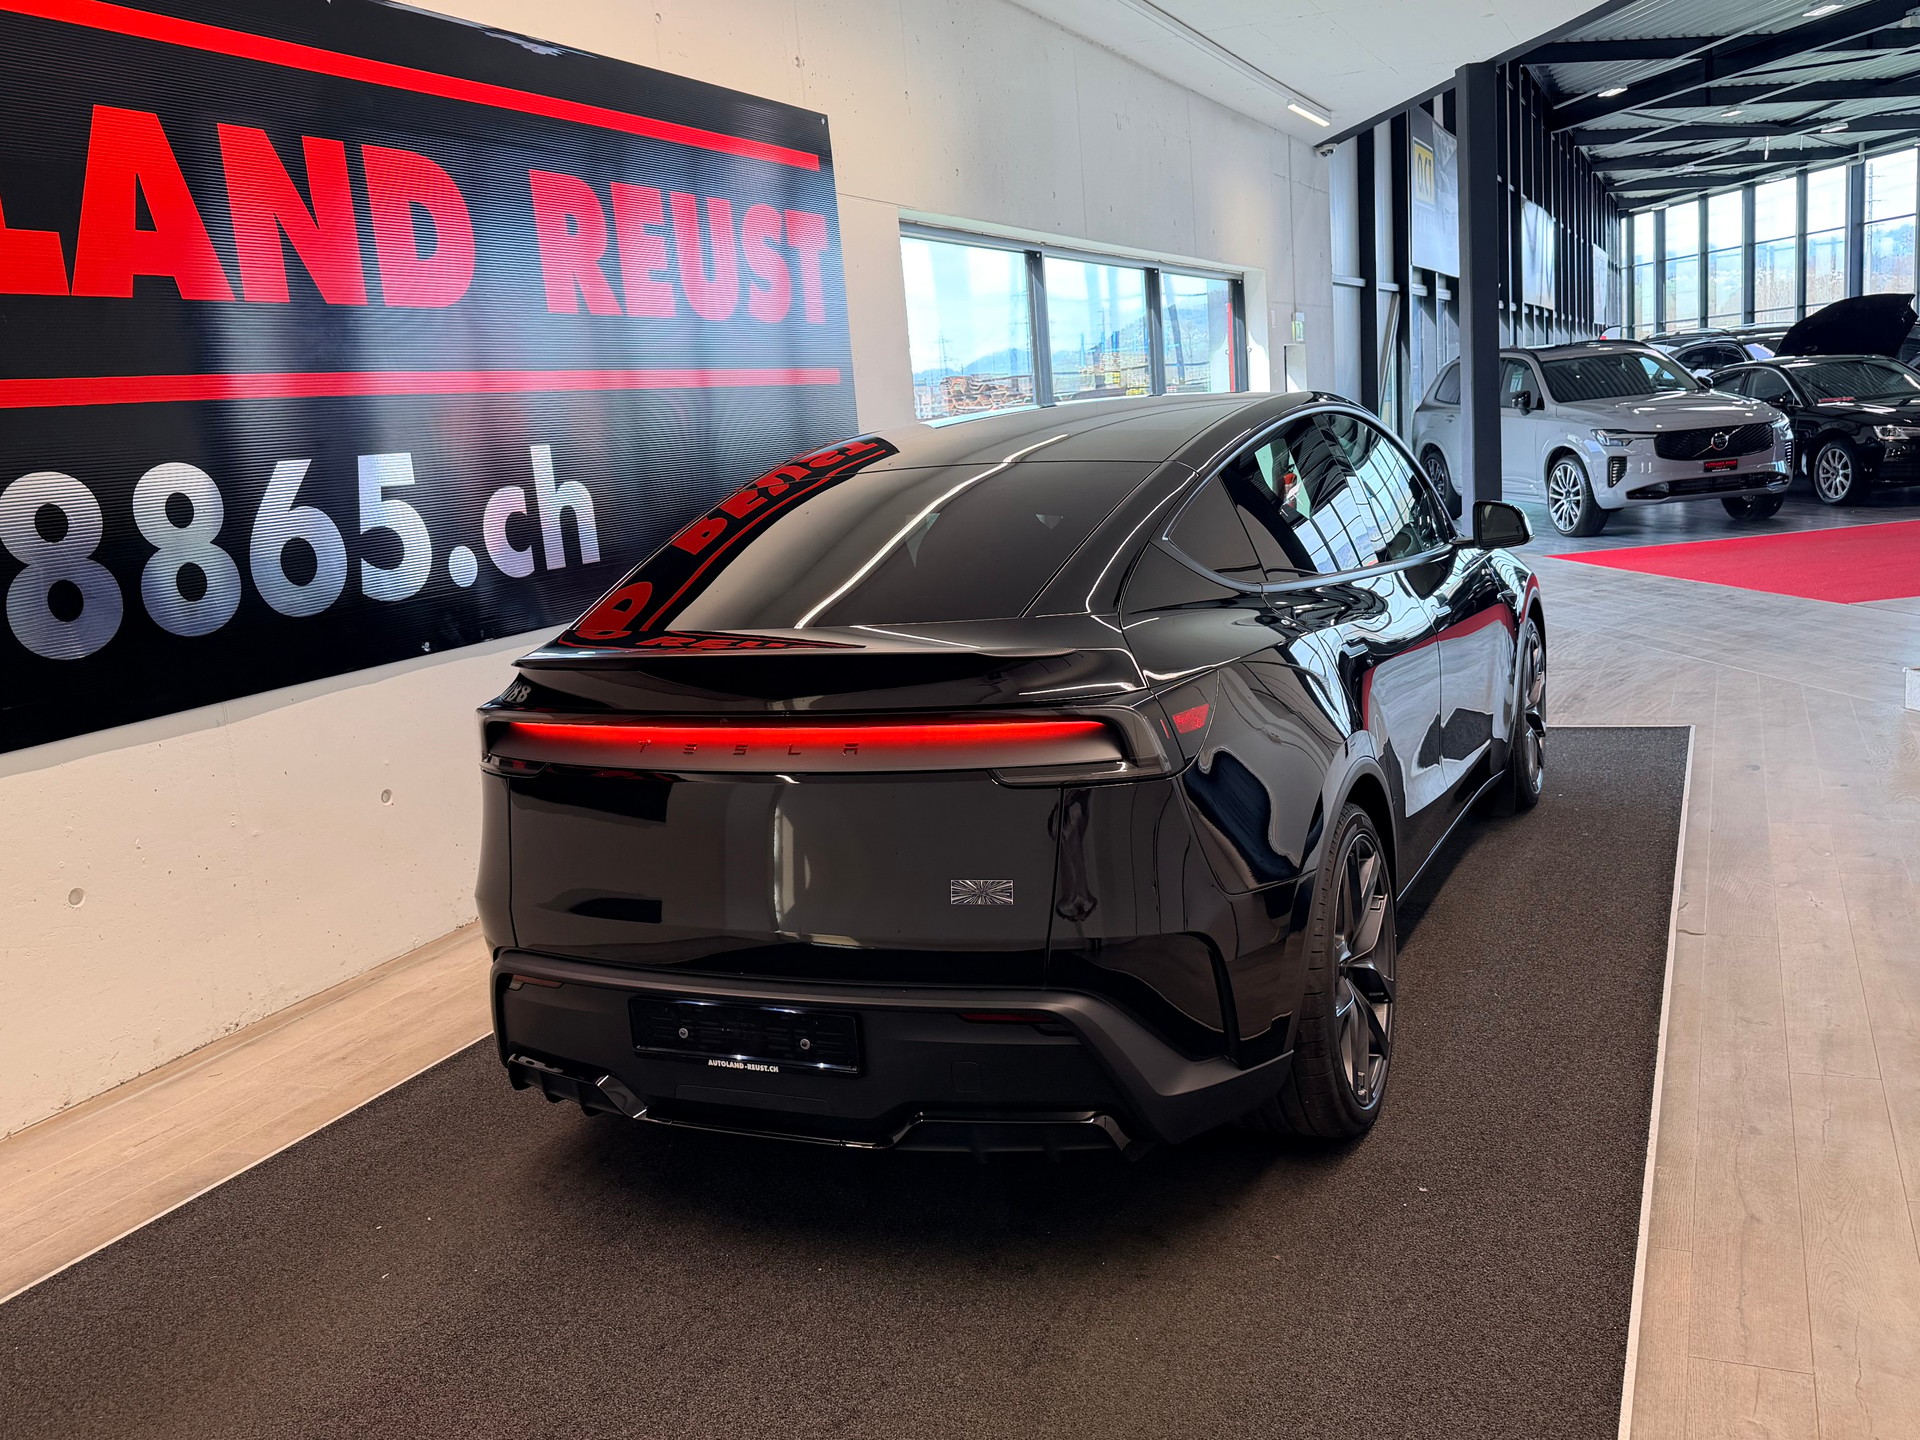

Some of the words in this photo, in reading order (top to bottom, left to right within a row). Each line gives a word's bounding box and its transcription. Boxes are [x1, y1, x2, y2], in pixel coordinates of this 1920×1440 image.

[527, 169, 827, 325] REUST
[0, 445, 600, 660] 8865.ch
[638, 739, 859, 756] TESLA
[708, 1059, 779, 1073] AUTOLAND-REUST.CH
